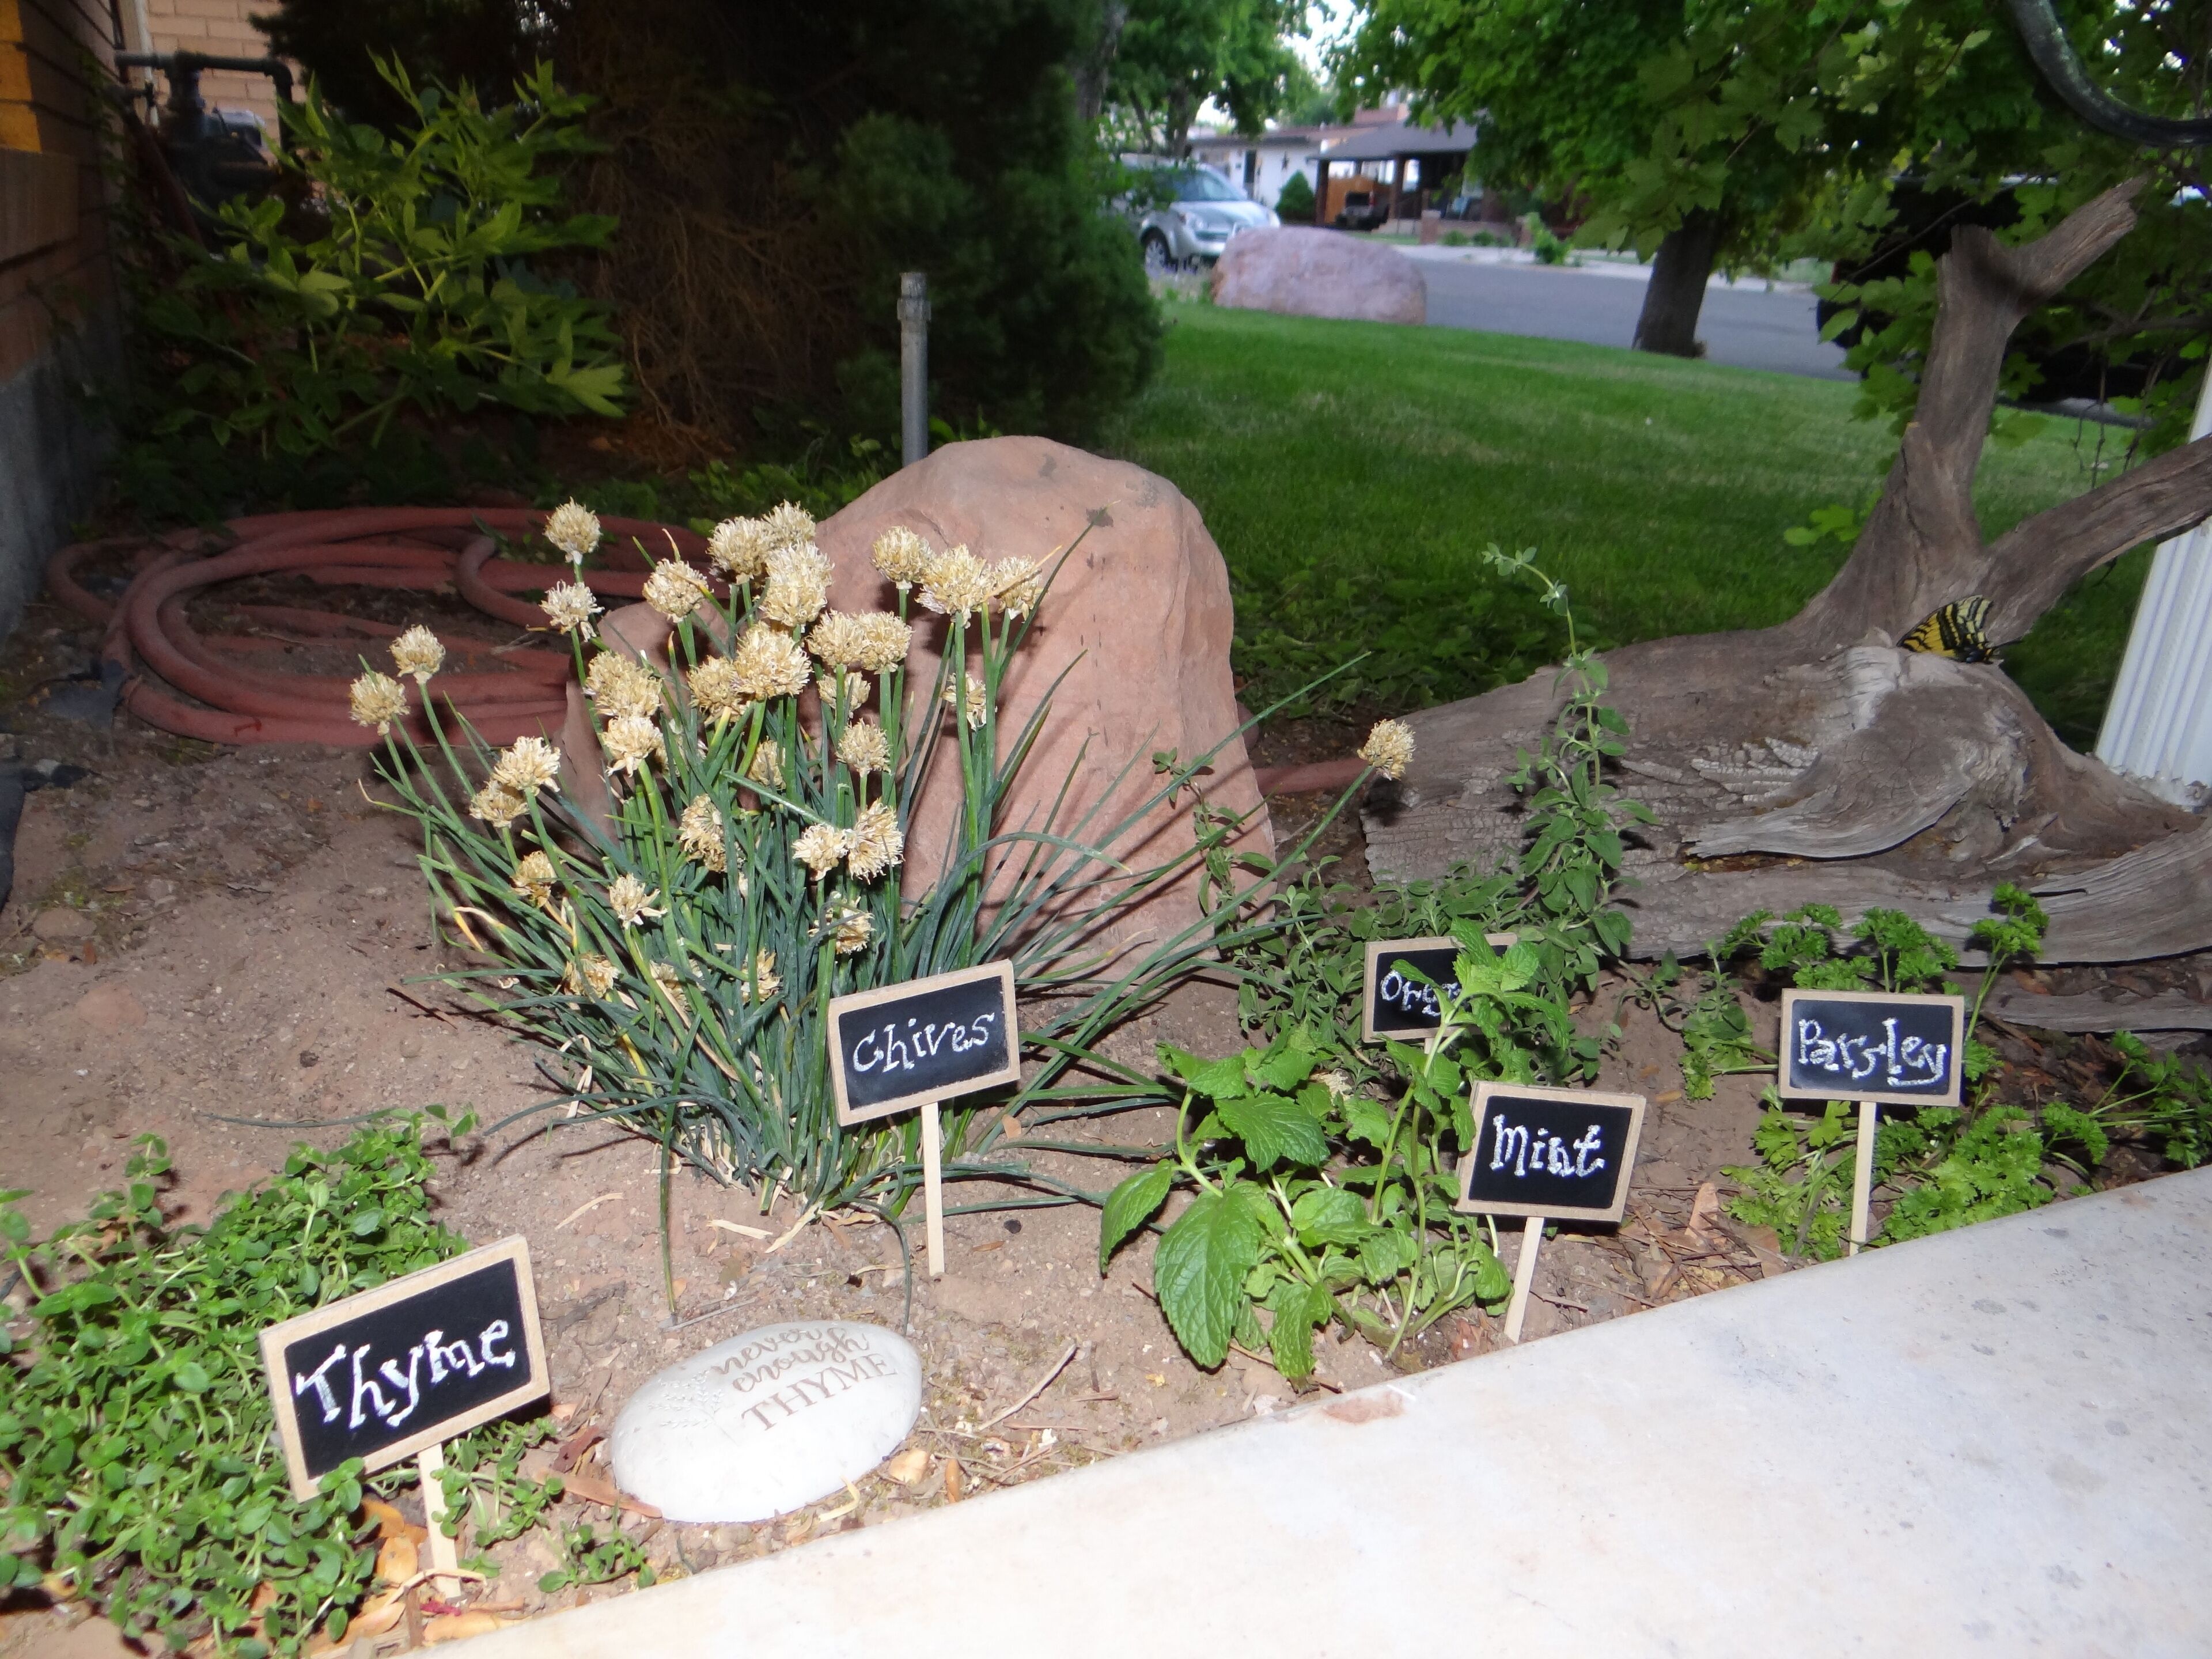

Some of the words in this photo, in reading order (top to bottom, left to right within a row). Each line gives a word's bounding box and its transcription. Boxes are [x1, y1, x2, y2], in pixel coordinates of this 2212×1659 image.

[853, 1012, 995, 1073] Chives
[1798, 1017, 1947, 1088] Parsley
[1489, 1113, 1605, 1177] Mint
[296, 1319, 516, 1430] Thyme
[711, 1327, 823, 1375] never
[732, 1327, 870, 1393] enough
[741, 1353, 899, 1431] THYME
